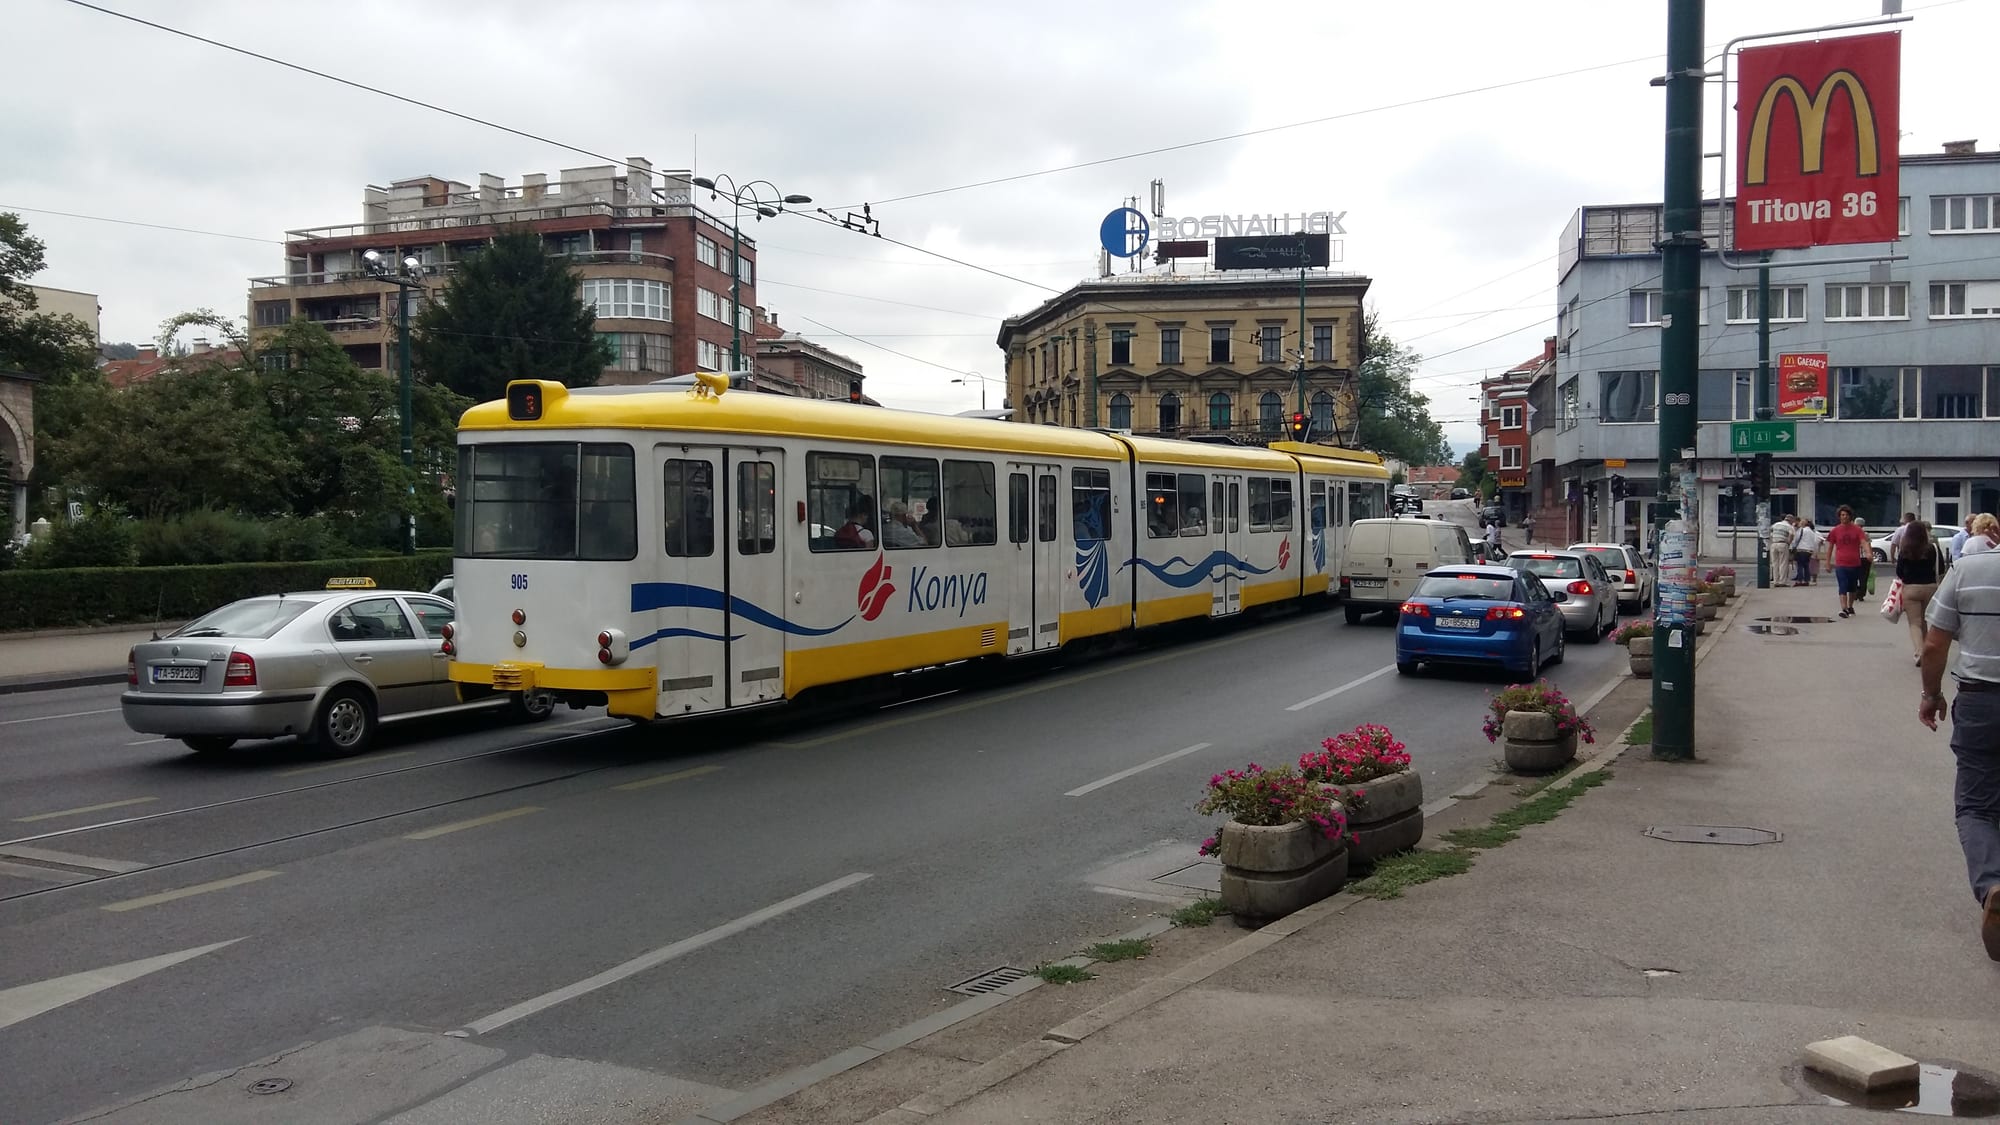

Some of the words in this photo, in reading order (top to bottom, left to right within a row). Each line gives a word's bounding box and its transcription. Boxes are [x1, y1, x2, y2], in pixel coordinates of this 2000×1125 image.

[1747, 197, 1831, 224] Titova
[1842, 191, 1877, 218] 36
[1778, 463, 1847, 476] SANPAOLO
[1851, 463, 1900, 476] BANKA
[511, 574, 528, 590] 905
[908, 565, 988, 618] Konya
